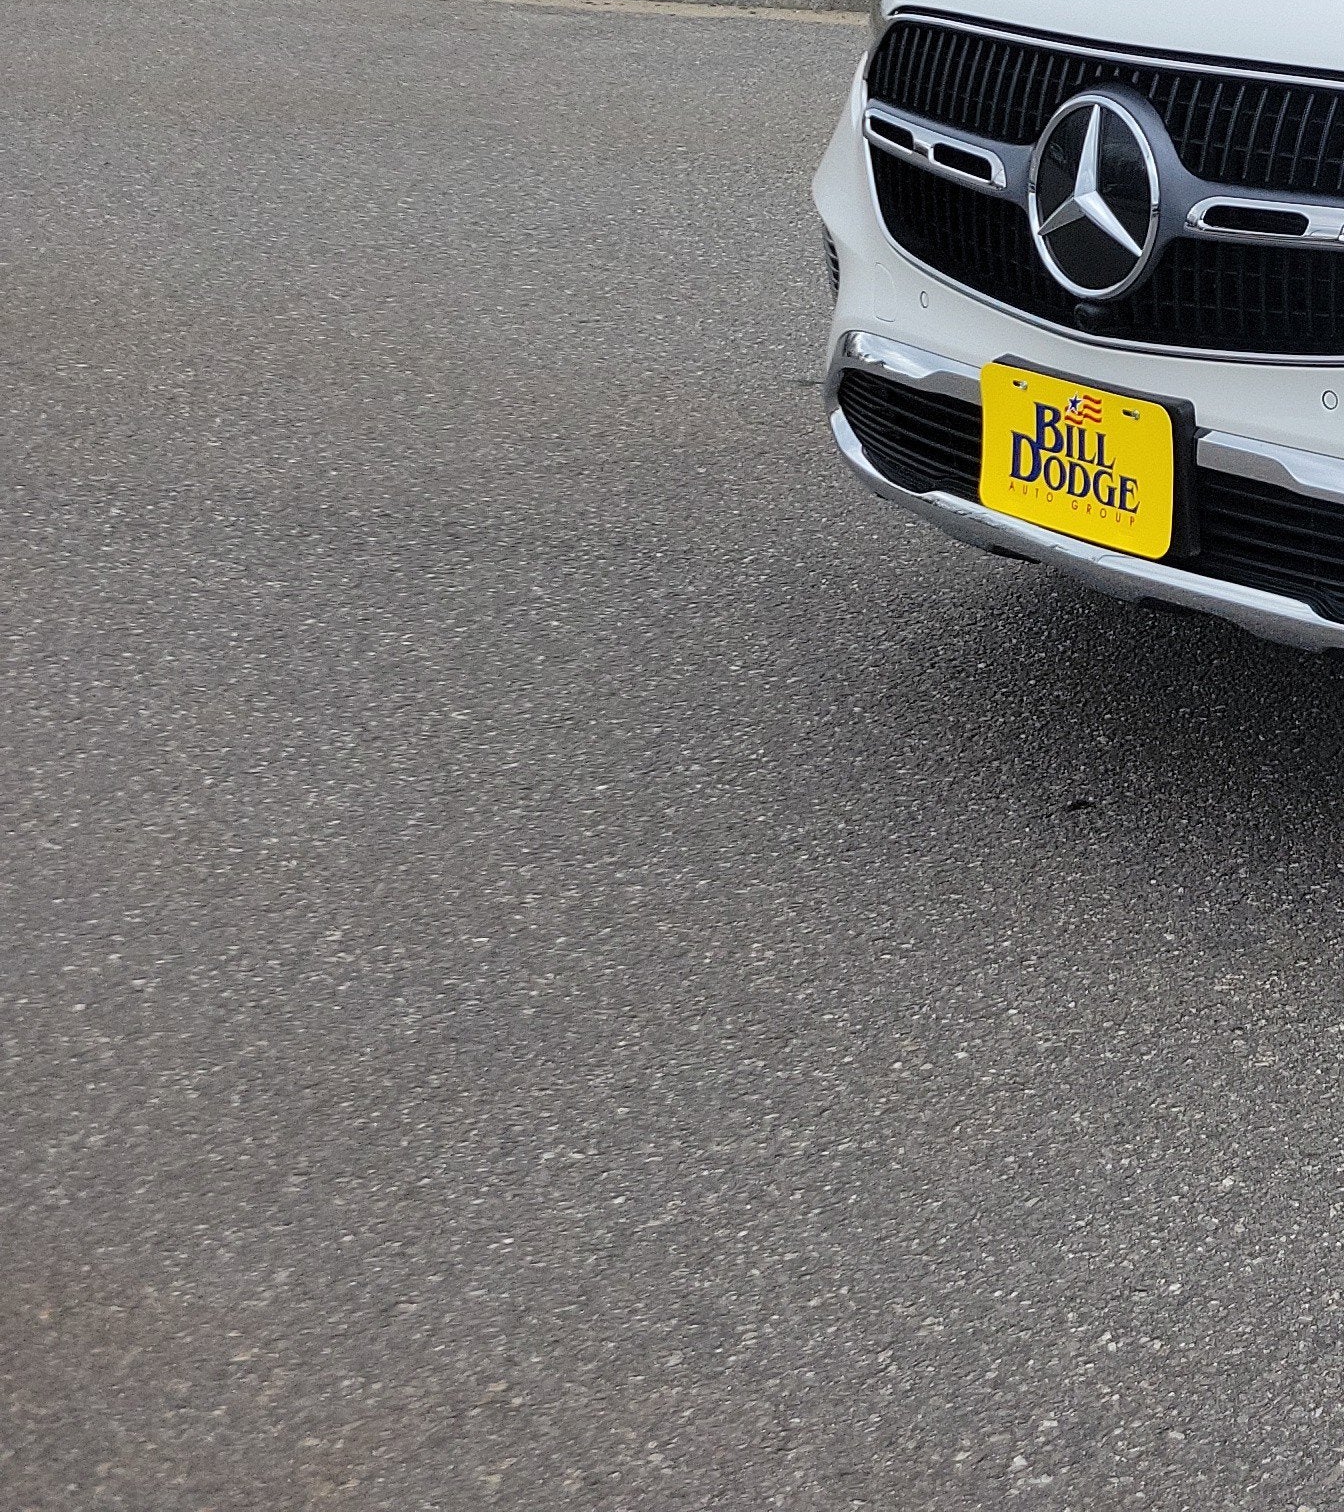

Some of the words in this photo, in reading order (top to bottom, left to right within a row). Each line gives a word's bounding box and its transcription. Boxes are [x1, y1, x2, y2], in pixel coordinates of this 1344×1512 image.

[1034, 401, 1116, 470] BILL
[1009, 429, 1141, 514] DODGE
[1009, 481, 1054, 503] AUTO
[1072, 499, 1136, 527] GROUP
